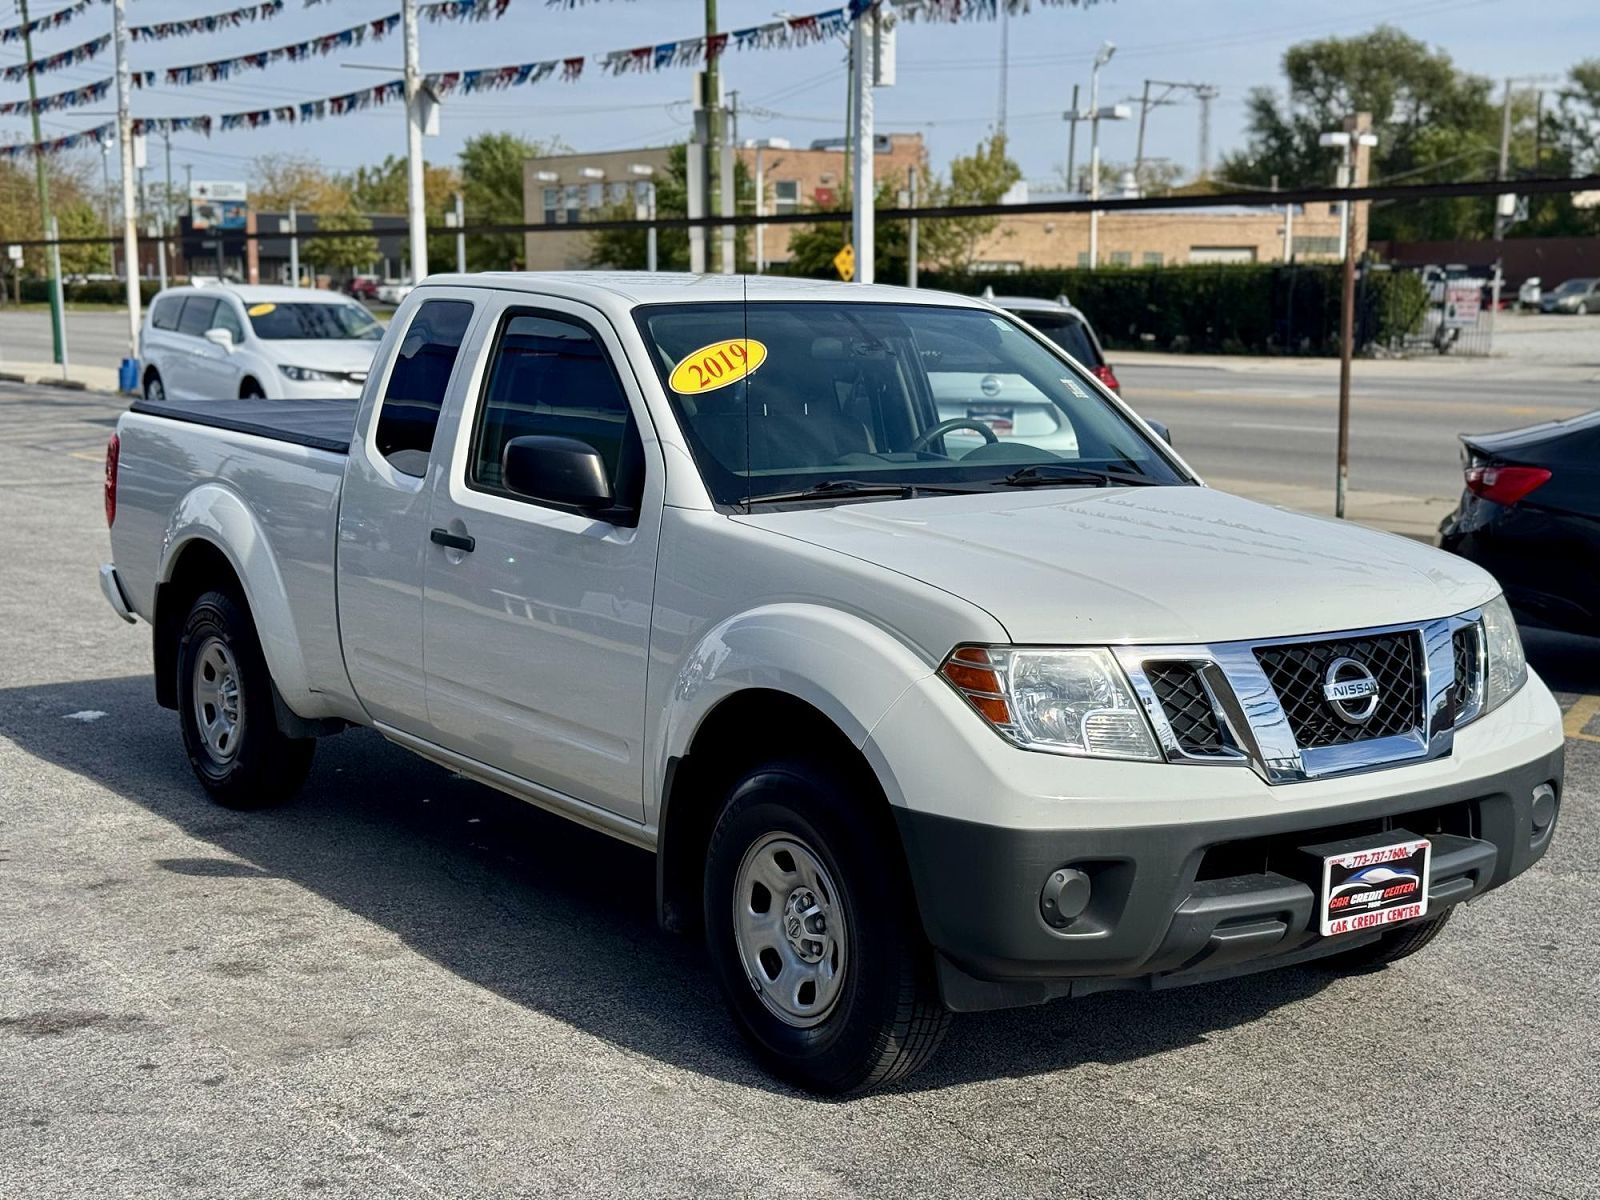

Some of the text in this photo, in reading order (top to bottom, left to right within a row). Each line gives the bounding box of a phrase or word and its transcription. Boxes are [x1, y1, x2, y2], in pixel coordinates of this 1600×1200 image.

[688, 343, 748, 388] 2019
[1333, 682, 1377, 697] NISSAN
[1352, 846, 1408, 866] 773-737-7600
[1330, 896, 1350, 909] CAR
[1350, 889, 1384, 905] CREDIT
[1384, 882, 1416, 898] CENTER
[1330, 920, 1348, 934] CAR
[1352, 911, 1384, 930] CREDIT
[1387, 904, 1421, 921] CENTER
